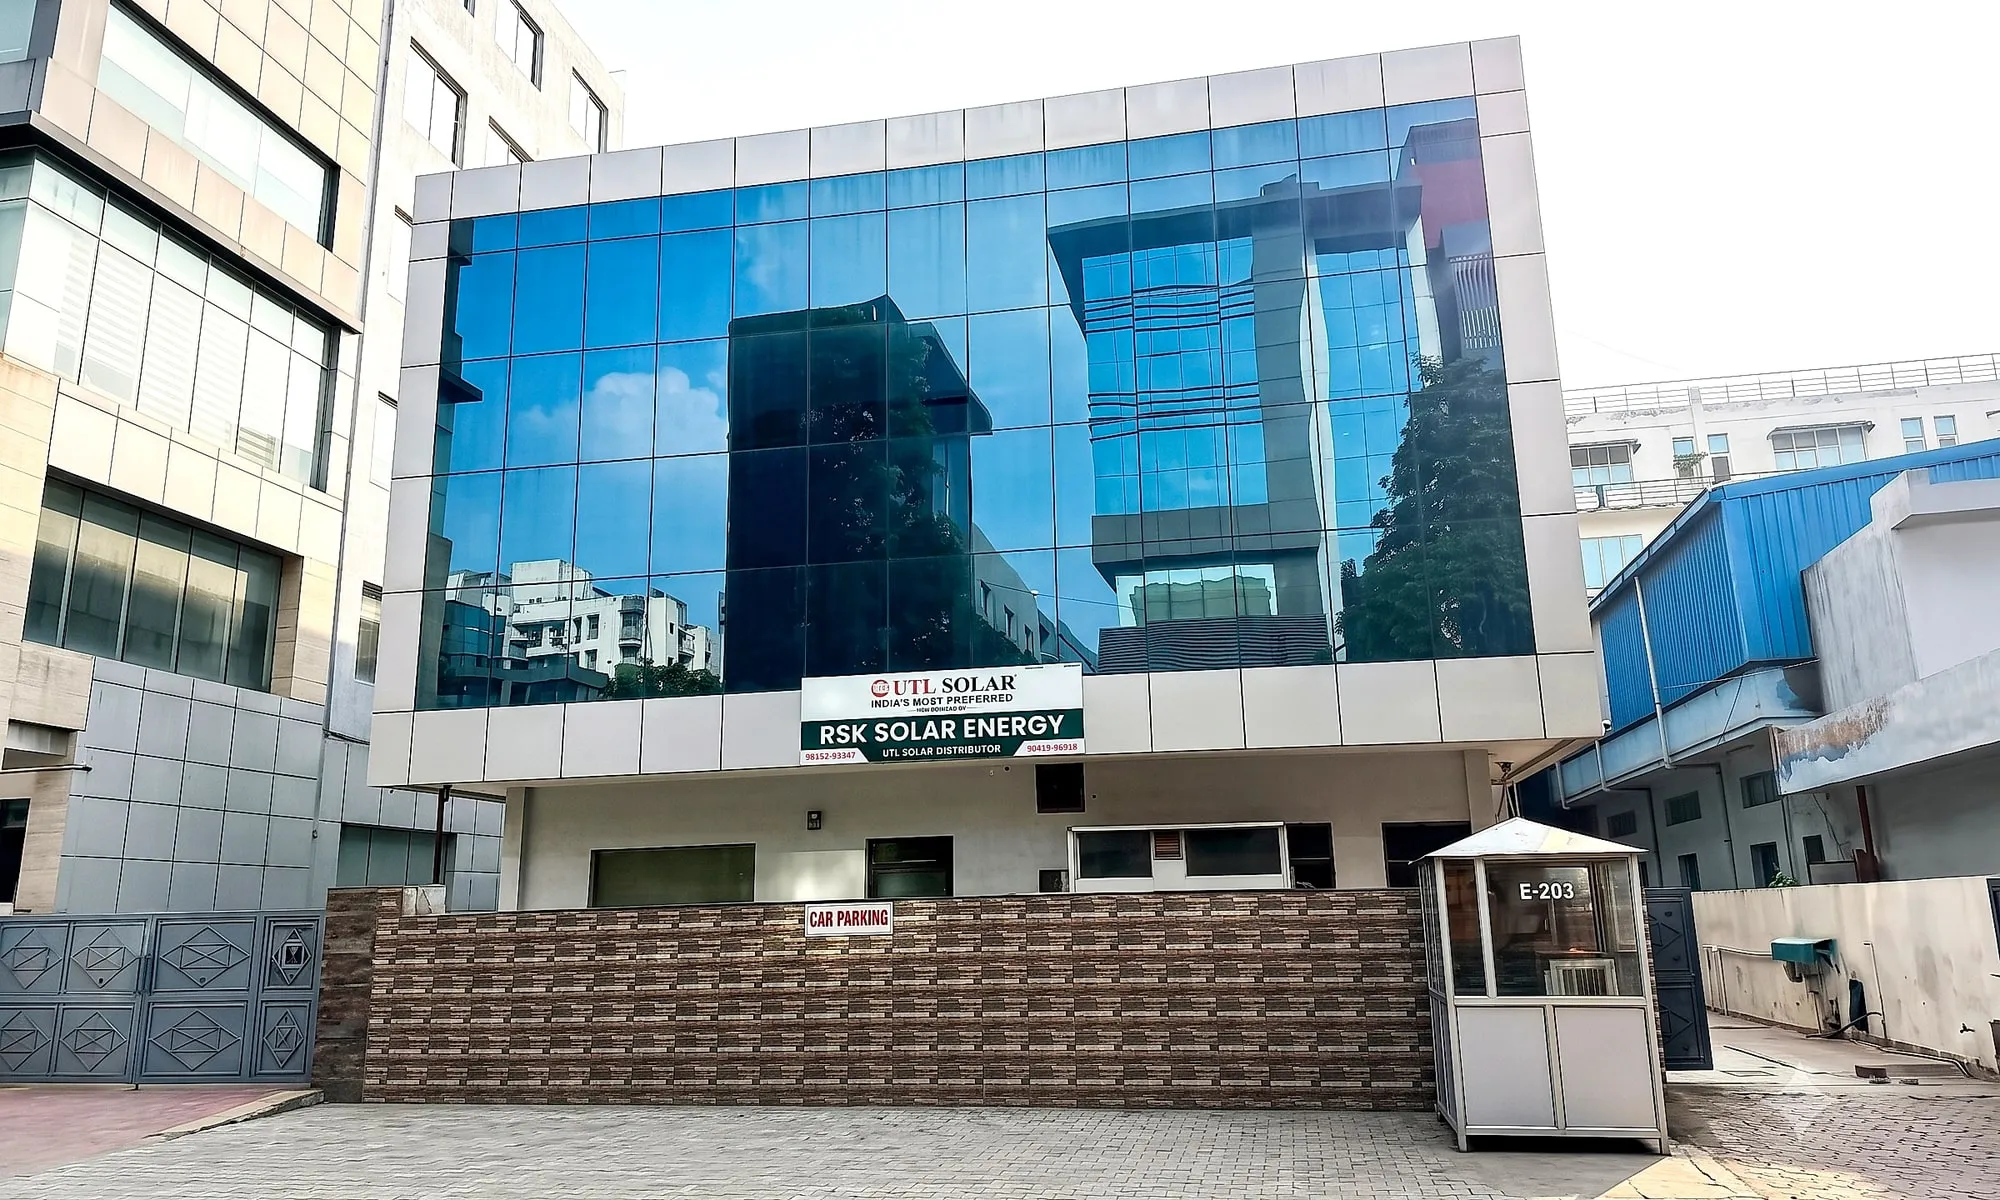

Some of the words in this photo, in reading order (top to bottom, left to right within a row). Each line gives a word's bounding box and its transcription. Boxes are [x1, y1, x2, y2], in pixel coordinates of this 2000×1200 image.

[893, 679, 936, 695] UTL
[942, 676, 1016, 693] SOLAR
[871, 699, 910, 708] INDIA'S
[912, 697, 944, 706] MOST
[946, 694, 1013, 704] PREFERRED
[820, 724, 868, 745] RSK
[874, 720, 956, 742] SOLAR
[963, 714, 1065, 738] ENERGY
[882, 749, 900, 757] UTL
[902, 747, 933, 756] SOLAR
[936, 744, 1001, 755] DISTRIBUTOR
[1027, 743, 1078, 752] 90419-96918
[805, 752, 856, 760] 98152-93347
[1519, 882, 1575, 900] E-203
[810, 911, 833, 927] CAR
[837, 909, 888, 926] PARKING
